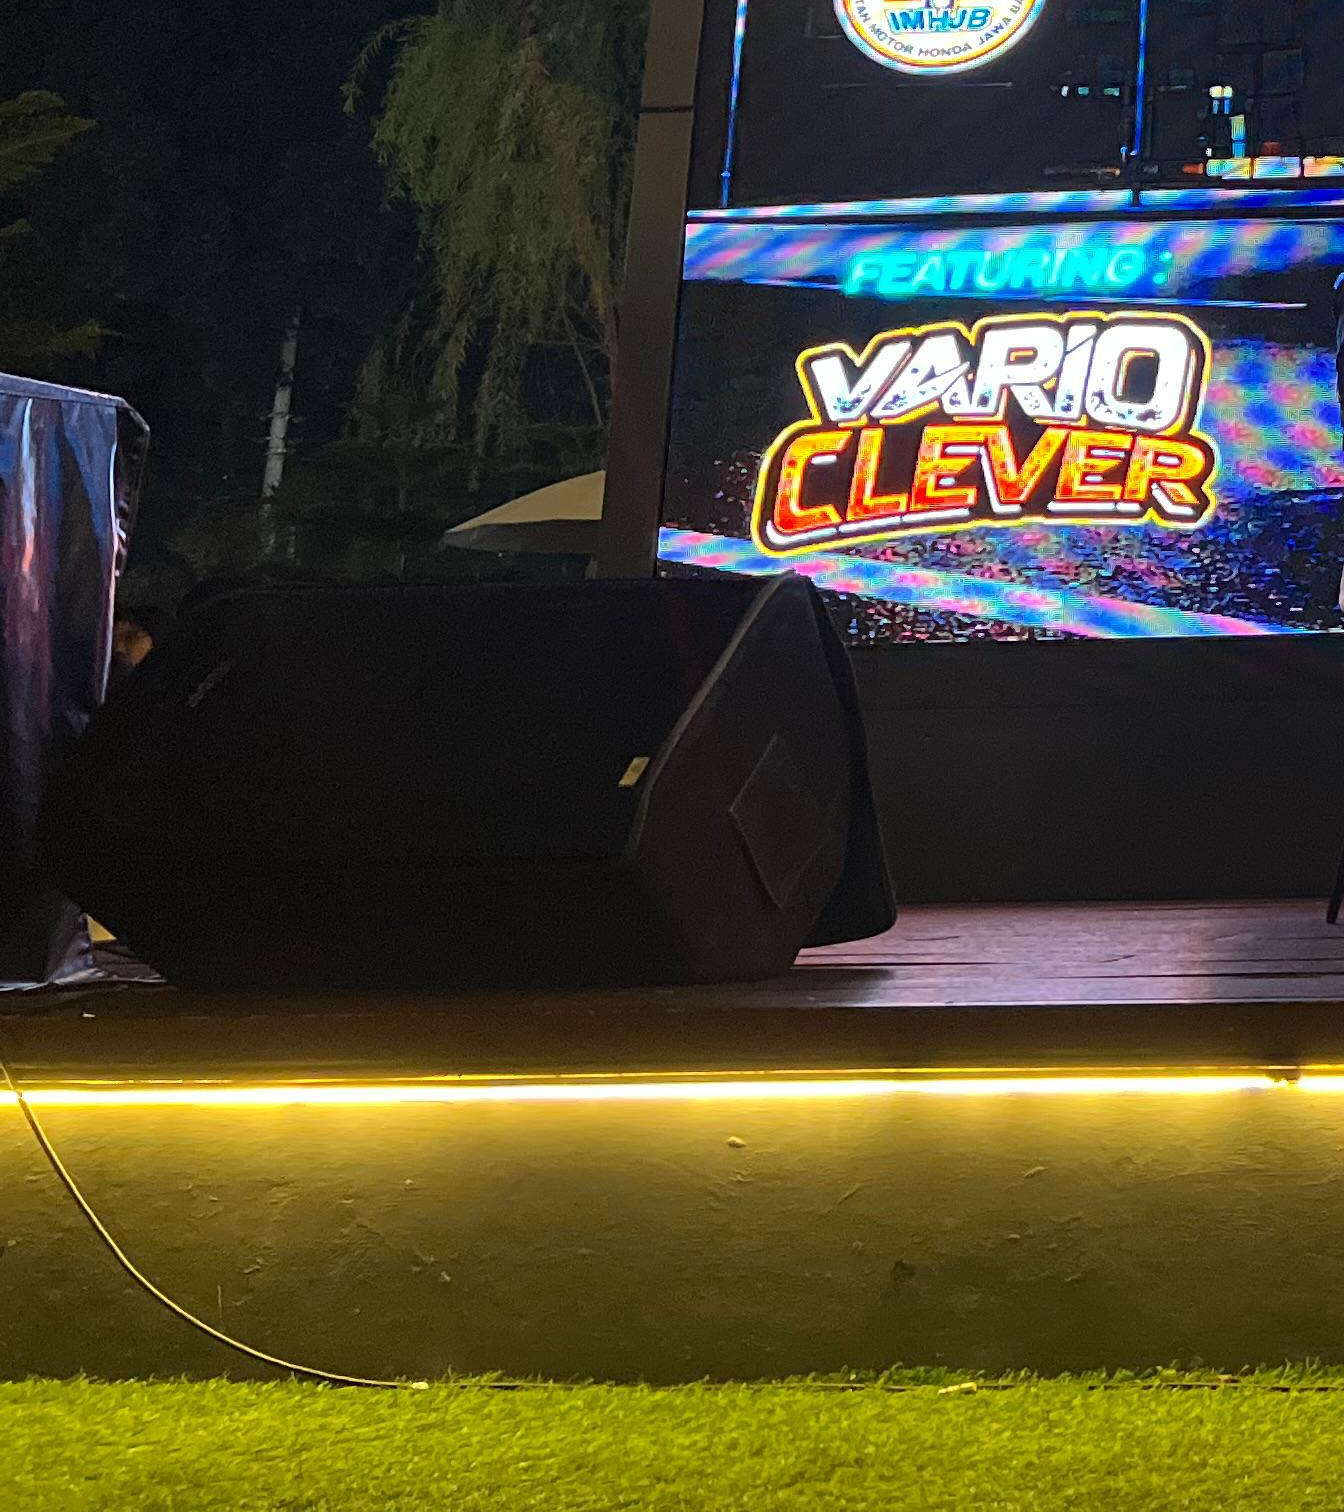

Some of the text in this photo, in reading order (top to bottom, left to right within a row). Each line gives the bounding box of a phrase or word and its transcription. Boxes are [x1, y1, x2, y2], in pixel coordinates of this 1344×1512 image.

[889, 8, 992, 31] IMHJB
[916, 42, 974, 58] HONDA
[809, 323, 1191, 431] VARIO
[773, 424, 1207, 535] CLEVER
